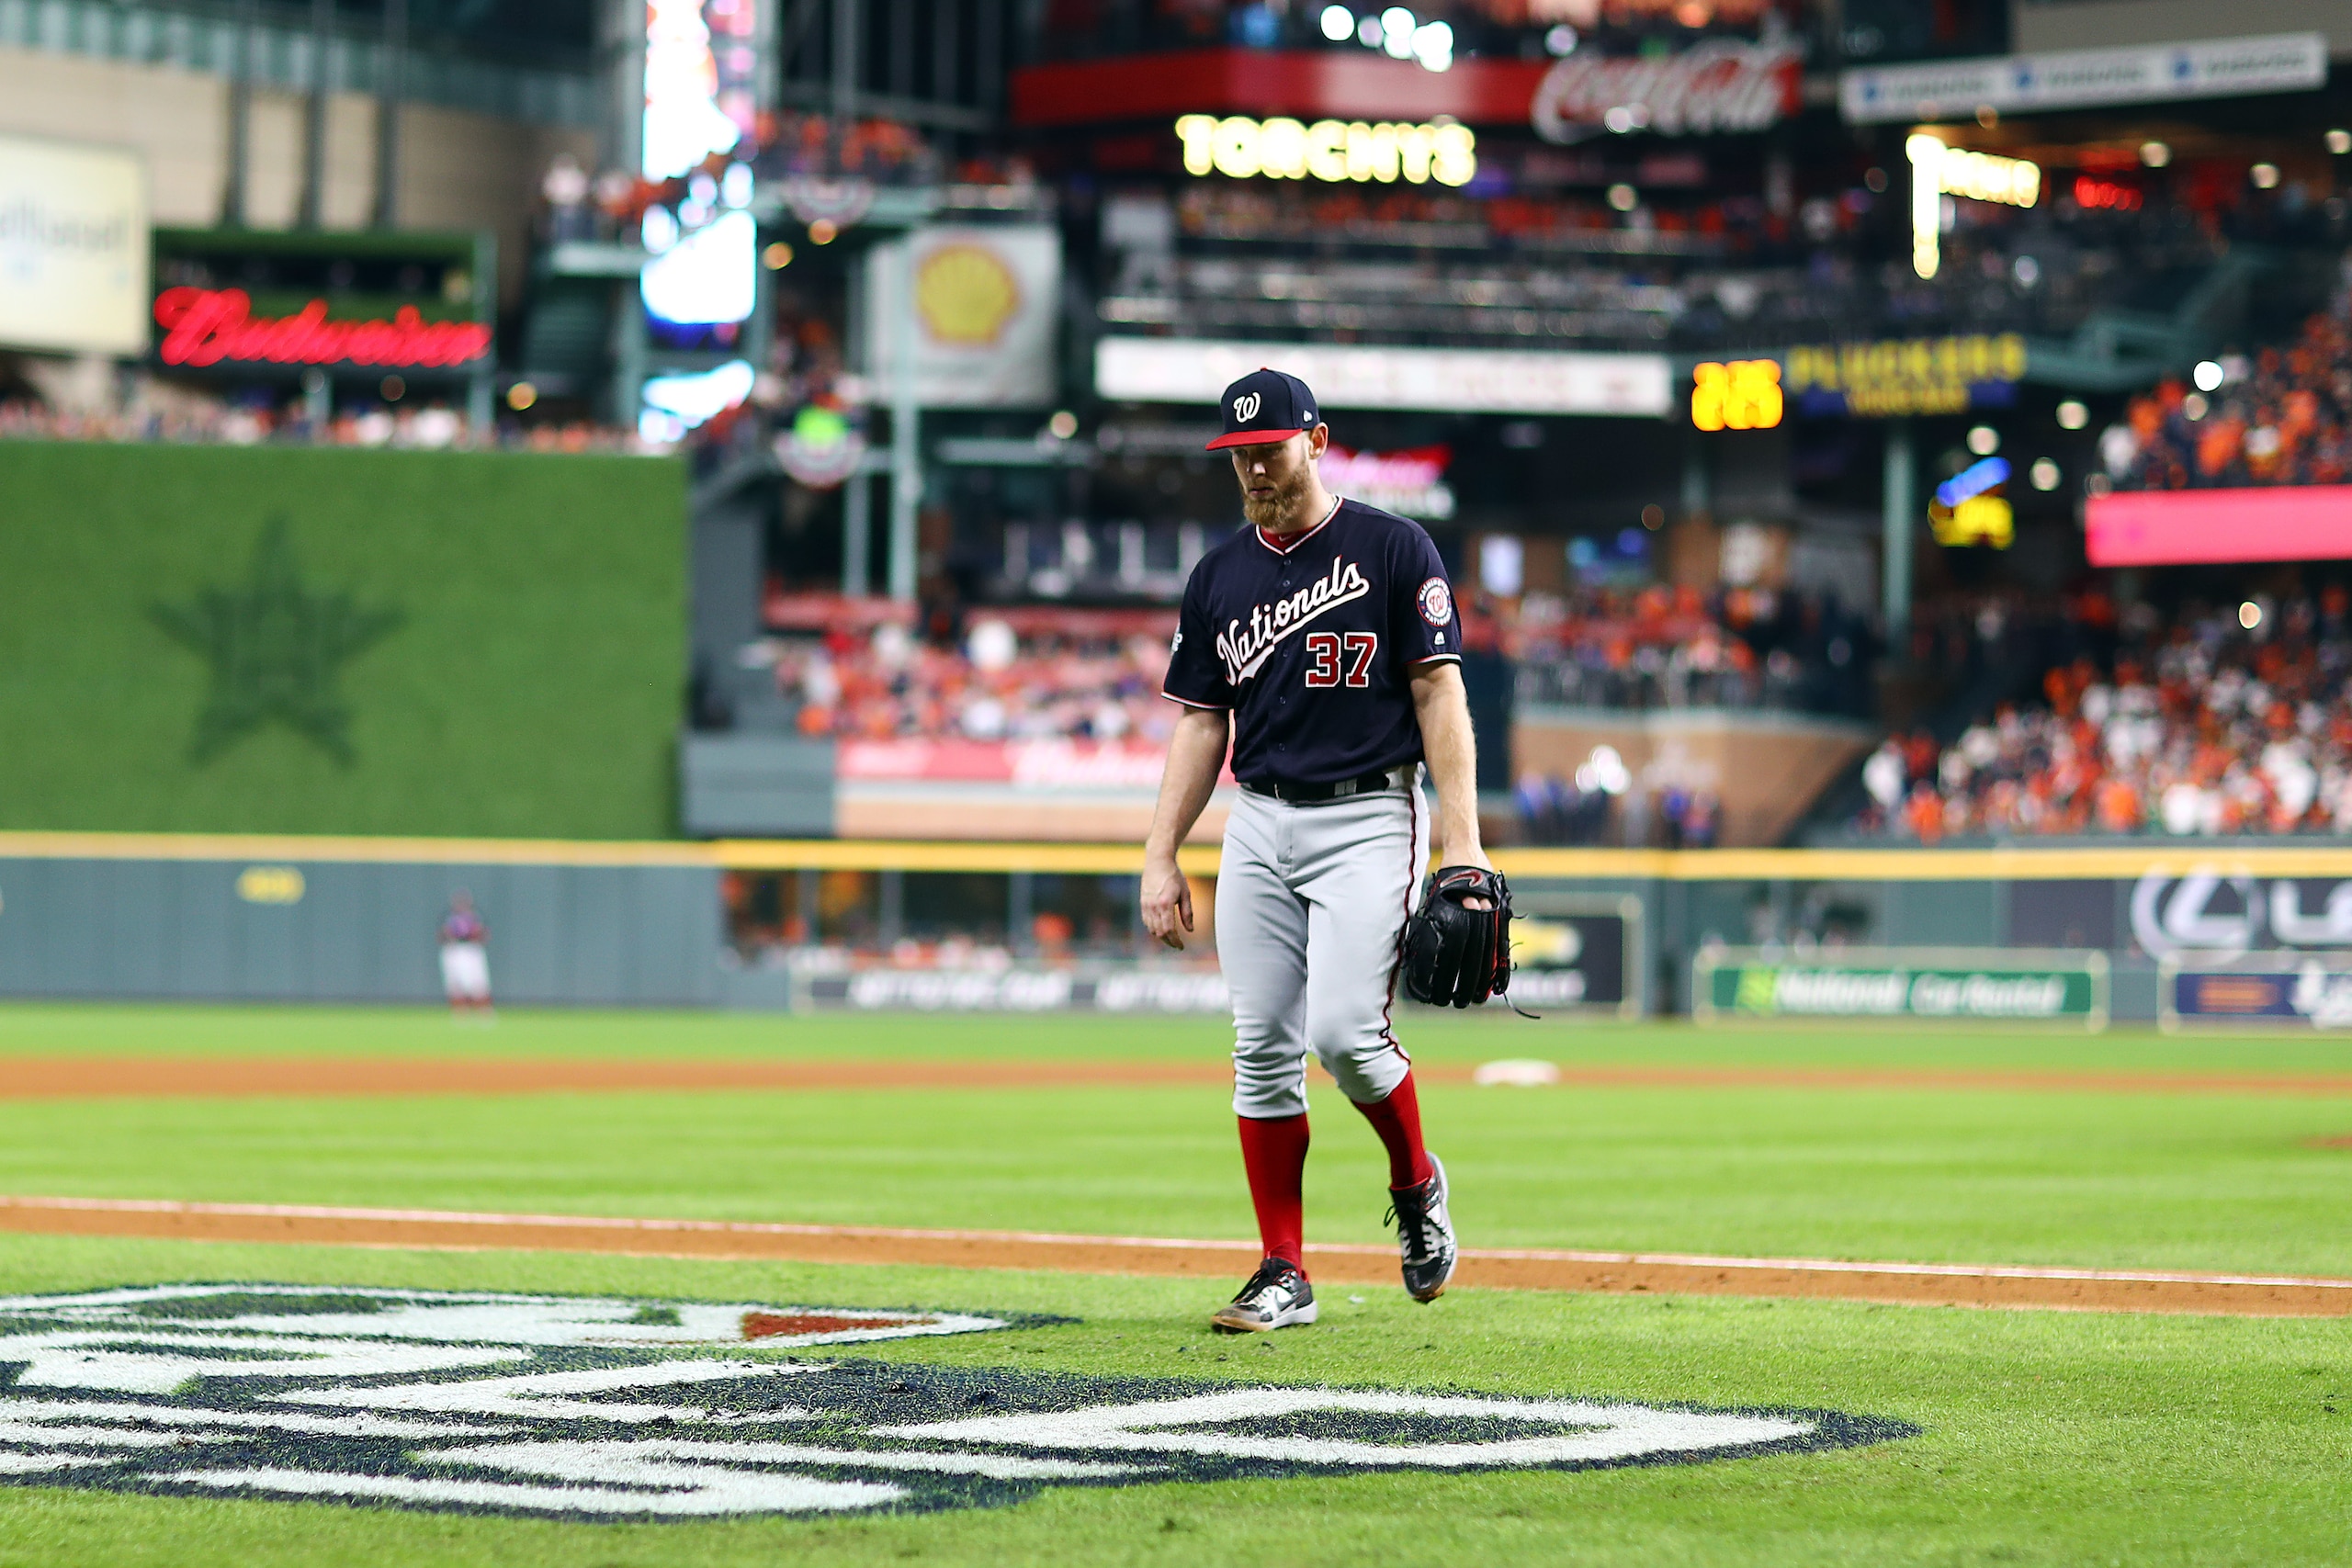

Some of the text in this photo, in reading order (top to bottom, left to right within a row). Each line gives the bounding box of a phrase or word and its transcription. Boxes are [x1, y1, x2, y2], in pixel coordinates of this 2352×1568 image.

[1233, 391, 1261, 423] W
[1216, 554, 1370, 686] Nationals
[1306, 632, 1377, 688] 37
